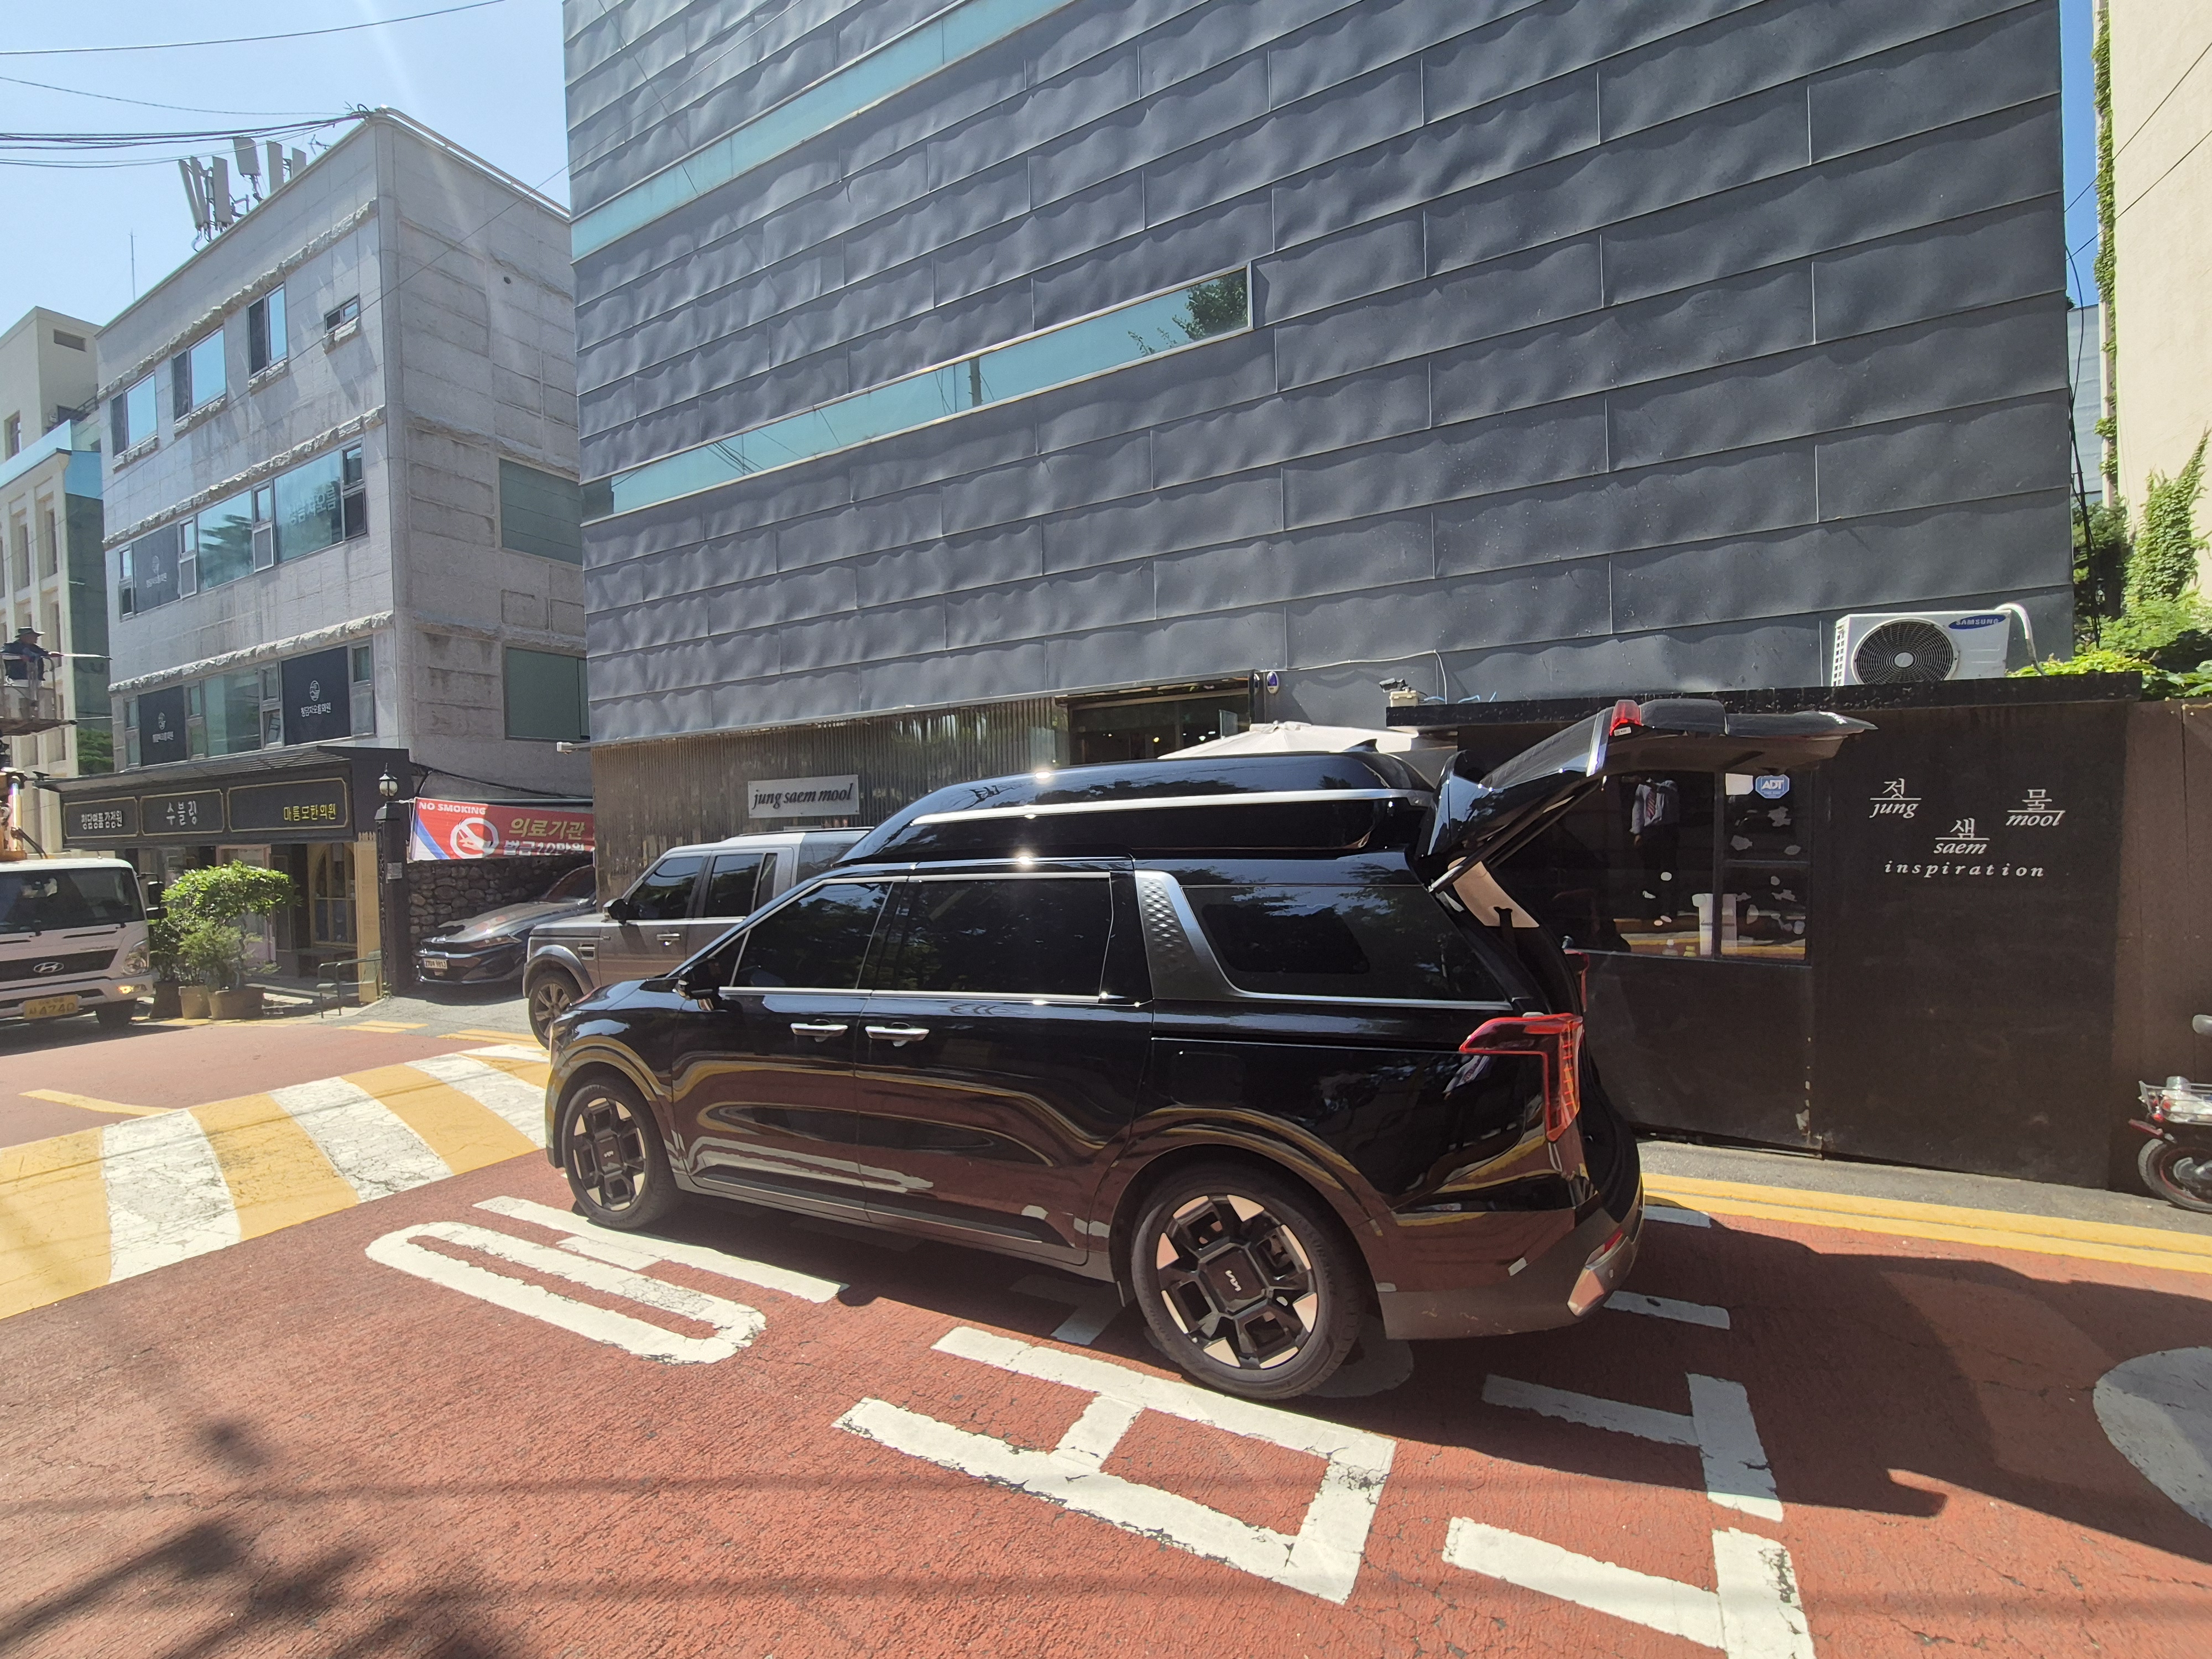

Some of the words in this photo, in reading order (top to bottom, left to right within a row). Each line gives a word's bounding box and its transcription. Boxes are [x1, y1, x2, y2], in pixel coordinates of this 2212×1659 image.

[1955, 618, 2000, 626] SAMSUNG
[1761, 779, 1785, 790] ADT
[1882, 778, 1906, 800] 정
[751, 789, 783, 810] jung
[783, 790, 817, 804] saem
[817, 782, 854, 802] mool
[2021, 789, 2053, 811] 물
[166, 800, 197, 826] 수블링
[283, 803, 336, 822] 마름모한의원
[418, 802, 435, 811] NO
[437, 803, 487, 816] SMOKING
[1868, 802, 1919, 820] jung
[2005, 809, 2066, 827] mool
[508, 817, 585, 841] 의료기관
[1949, 817, 1976, 839] 샘
[1933, 841, 1988, 855] saem
[1884, 860, 2045, 879] inspiration
